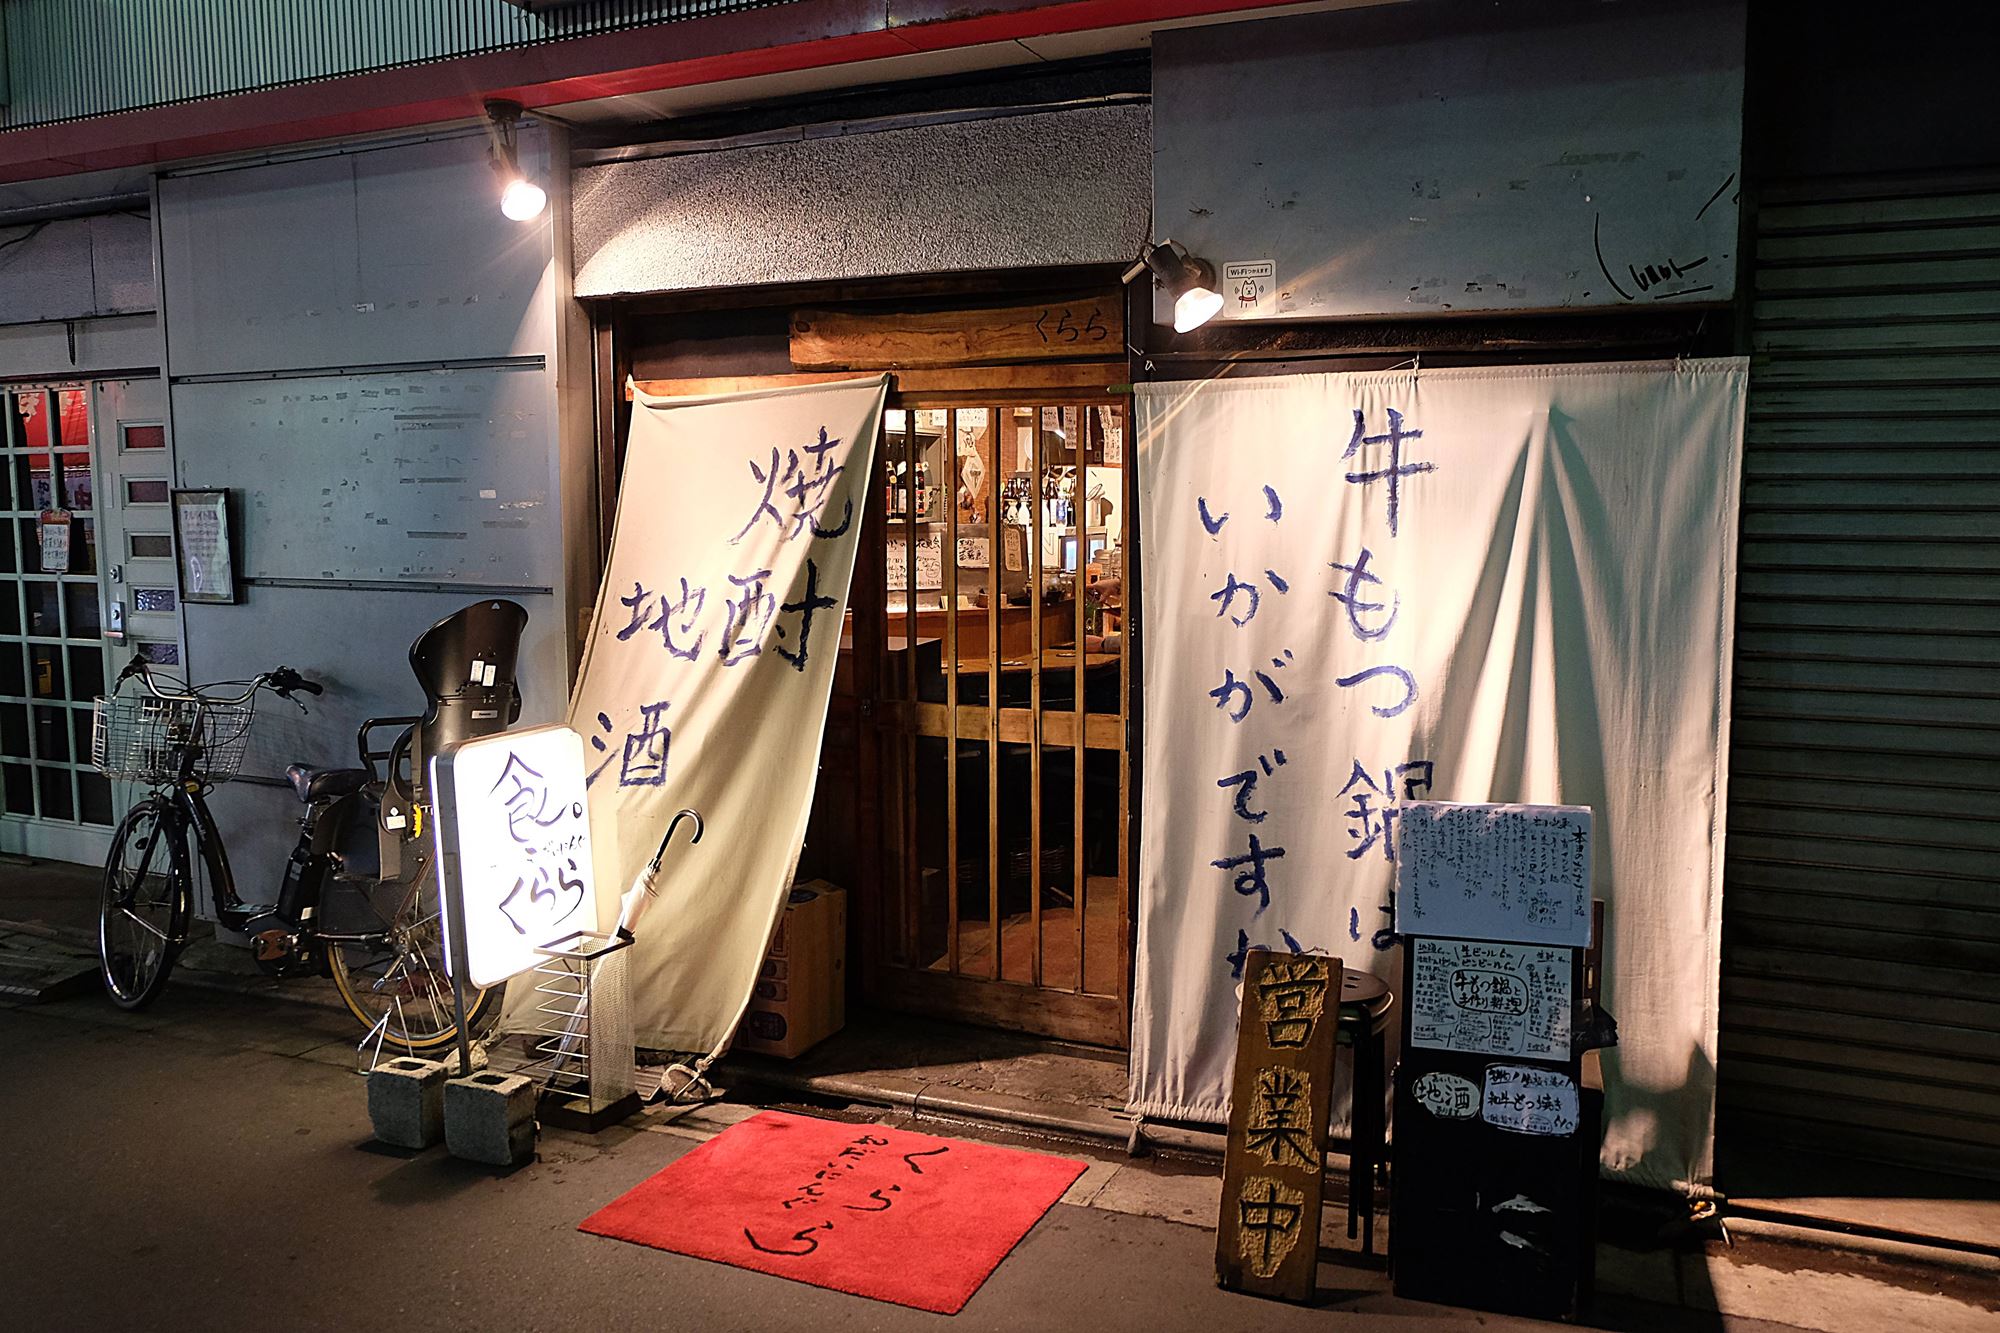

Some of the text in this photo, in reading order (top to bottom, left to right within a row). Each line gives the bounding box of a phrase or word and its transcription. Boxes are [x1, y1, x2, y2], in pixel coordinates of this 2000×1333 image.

[1034, 308, 1109, 343] くらら
[717, 425, 853, 673] 焼酎
[586, 577, 705, 791] 地酒
[499, 858, 585, 935] くらら
[1458, 993, 1523, 1014] 手作り料理
[1239, 961, 1326, 1265] 営業中
[1416, 1080, 1470, 1110] 地酒
[1487, 1090, 1563, 1112] 和牛もつ焼き
[743, 1146, 950, 1257] くらら
